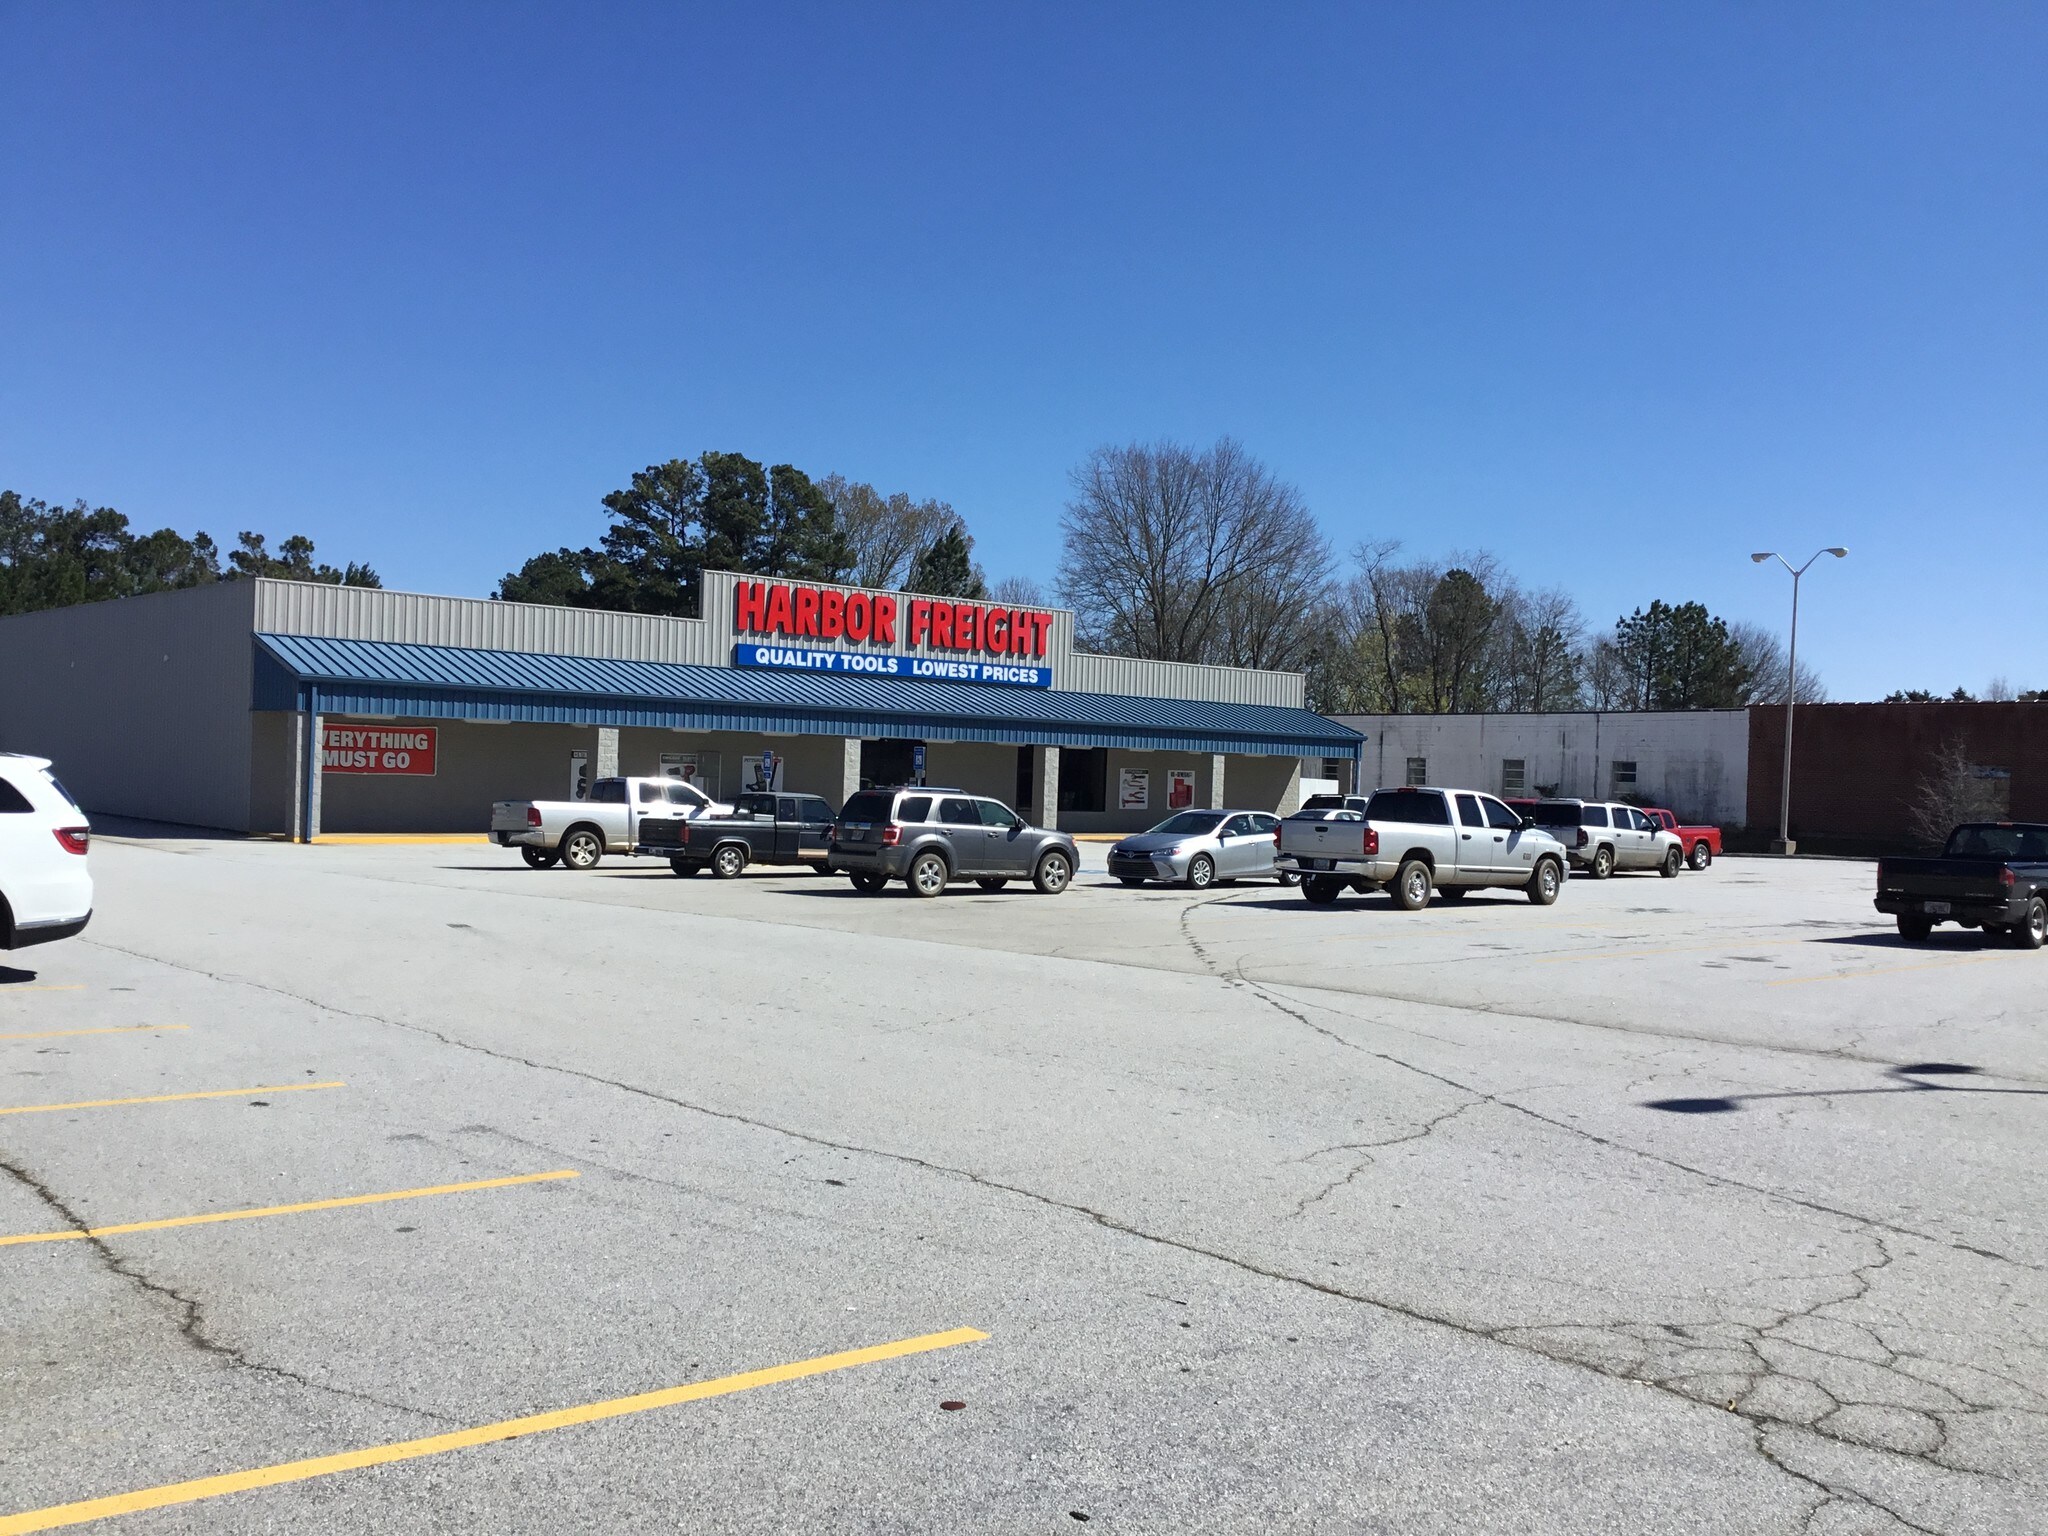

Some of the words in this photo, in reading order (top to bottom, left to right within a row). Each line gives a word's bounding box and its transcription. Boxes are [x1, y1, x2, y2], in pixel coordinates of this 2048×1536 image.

[737, 581, 896, 643] HARBOR
[911, 599, 1053, 656] FREIGHT
[755, 647, 836, 669] QUALITY
[840, 654, 898, 673] TOOLS
[912, 660, 978, 679] LOWEST
[982, 665, 1039, 683] PRICES
[322, 729, 428, 750] VERYTHING
[322, 749, 379, 768] MUST
[382, 752, 410, 769] GO
